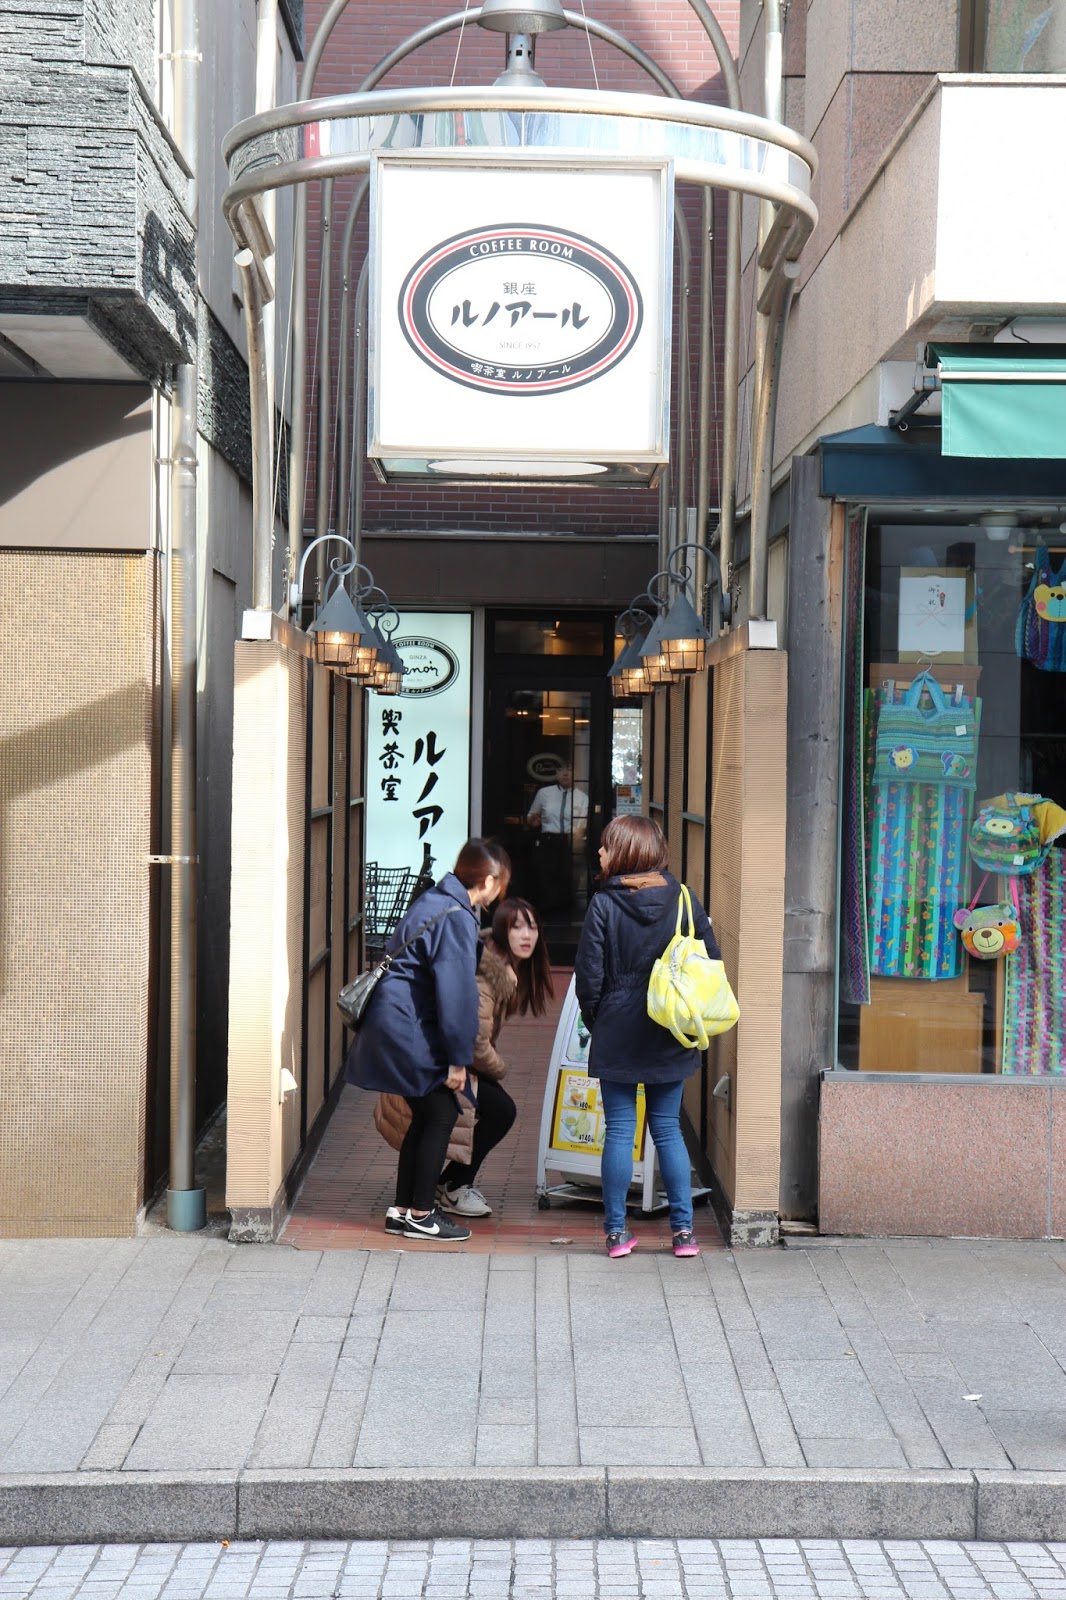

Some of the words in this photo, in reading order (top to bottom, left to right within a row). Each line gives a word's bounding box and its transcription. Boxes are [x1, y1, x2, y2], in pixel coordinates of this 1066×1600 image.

[470, 239, 522, 256] COFFEE
[530, 240, 573, 258] ROOM
[502, 281, 537, 295] 銀座
[451, 299, 590, 330] ルノアール
[470, 362, 506, 379] 喫茶室
[512, 364, 571, 379] ルノアール
[378, 708, 405, 802] 喫茶室
[412, 730, 447, 884] ルノアー
